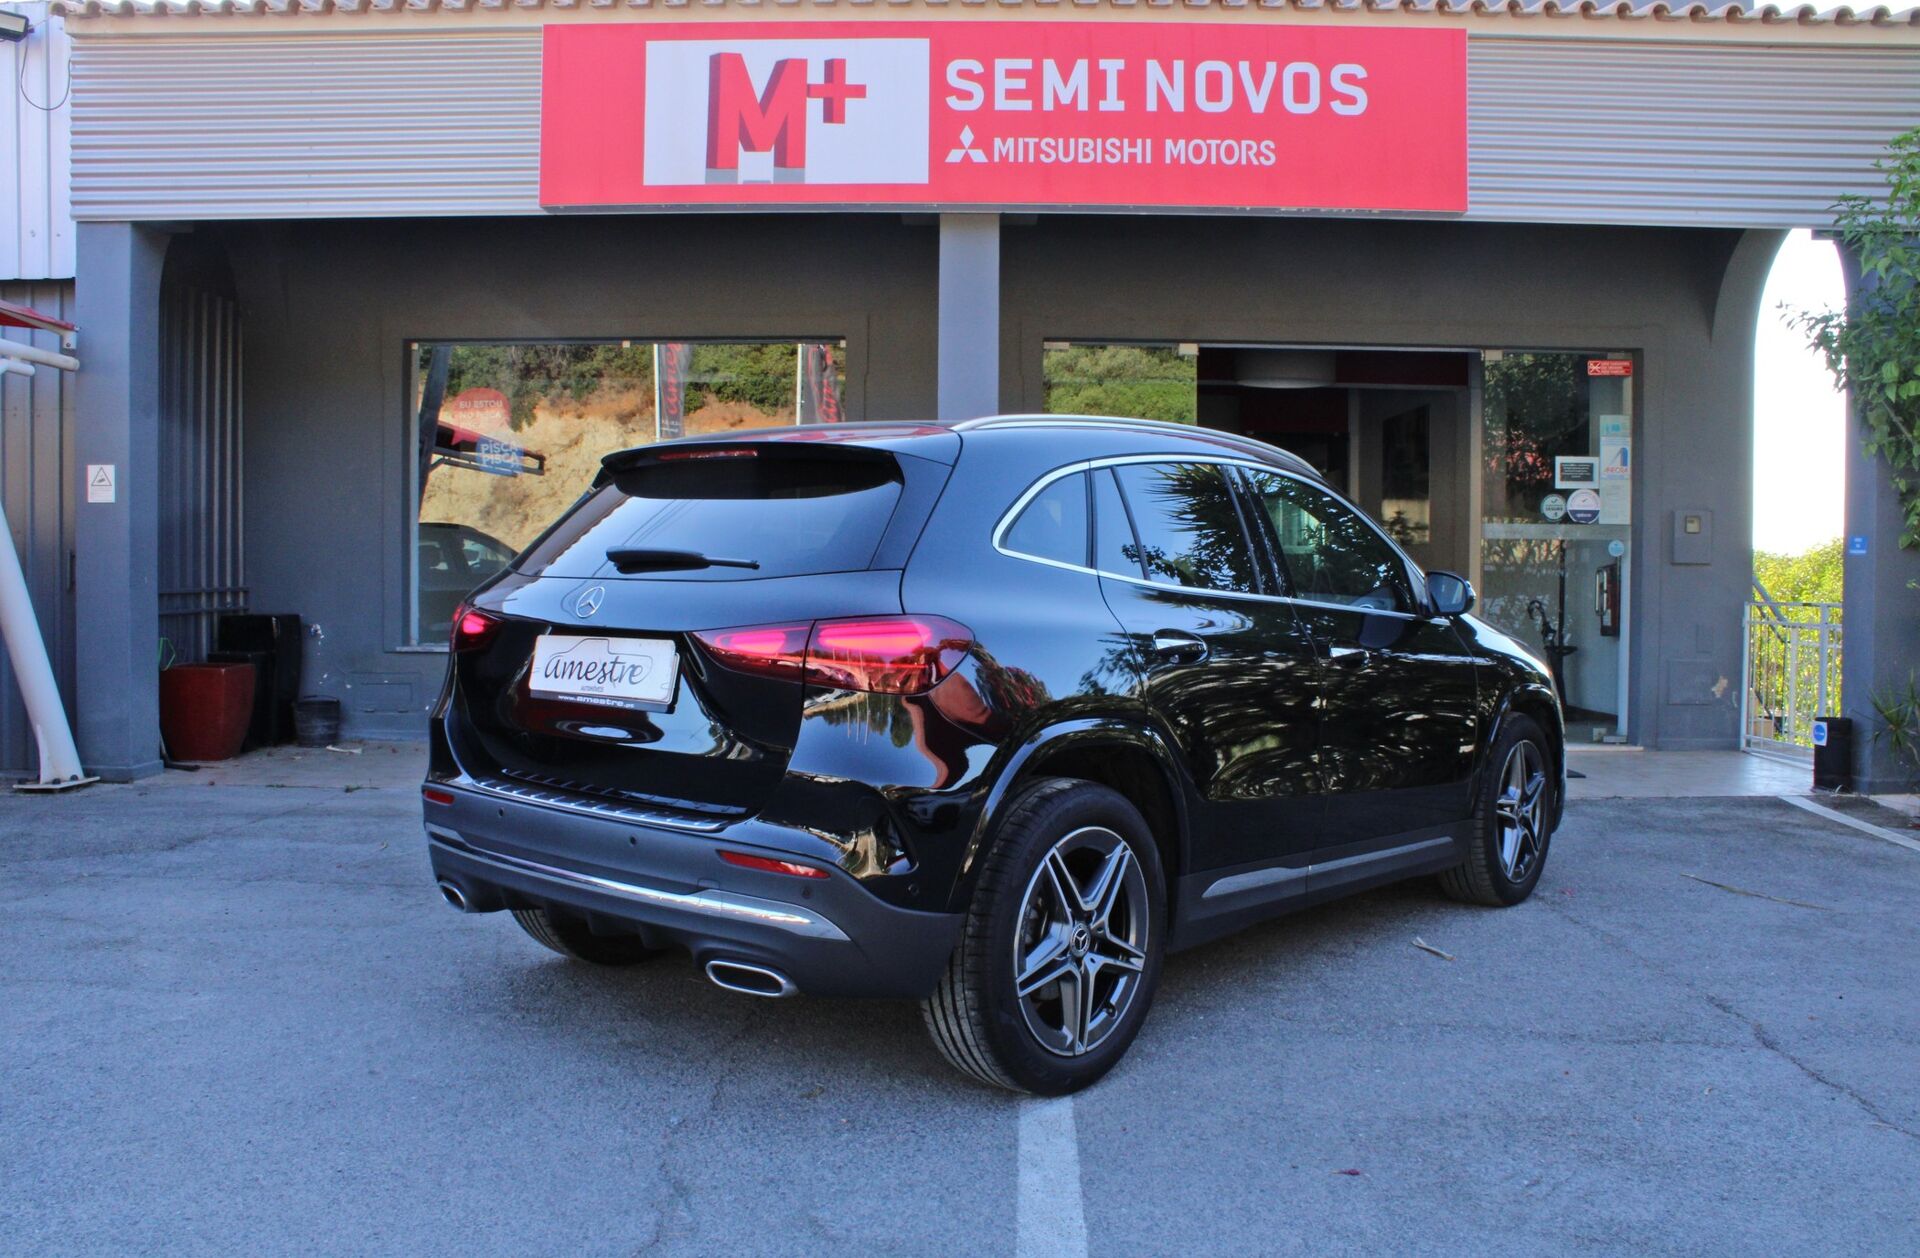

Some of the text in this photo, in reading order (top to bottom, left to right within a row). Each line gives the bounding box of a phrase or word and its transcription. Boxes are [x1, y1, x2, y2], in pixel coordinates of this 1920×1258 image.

[945, 58, 1369, 116] SEMI NOVOS
[993, 137, 1277, 166] MITSUBISHI MOTORS
[473, 399, 503, 409] ESTOU
[482, 451, 520, 465] PISCA
[544, 655, 645, 685] amestre
